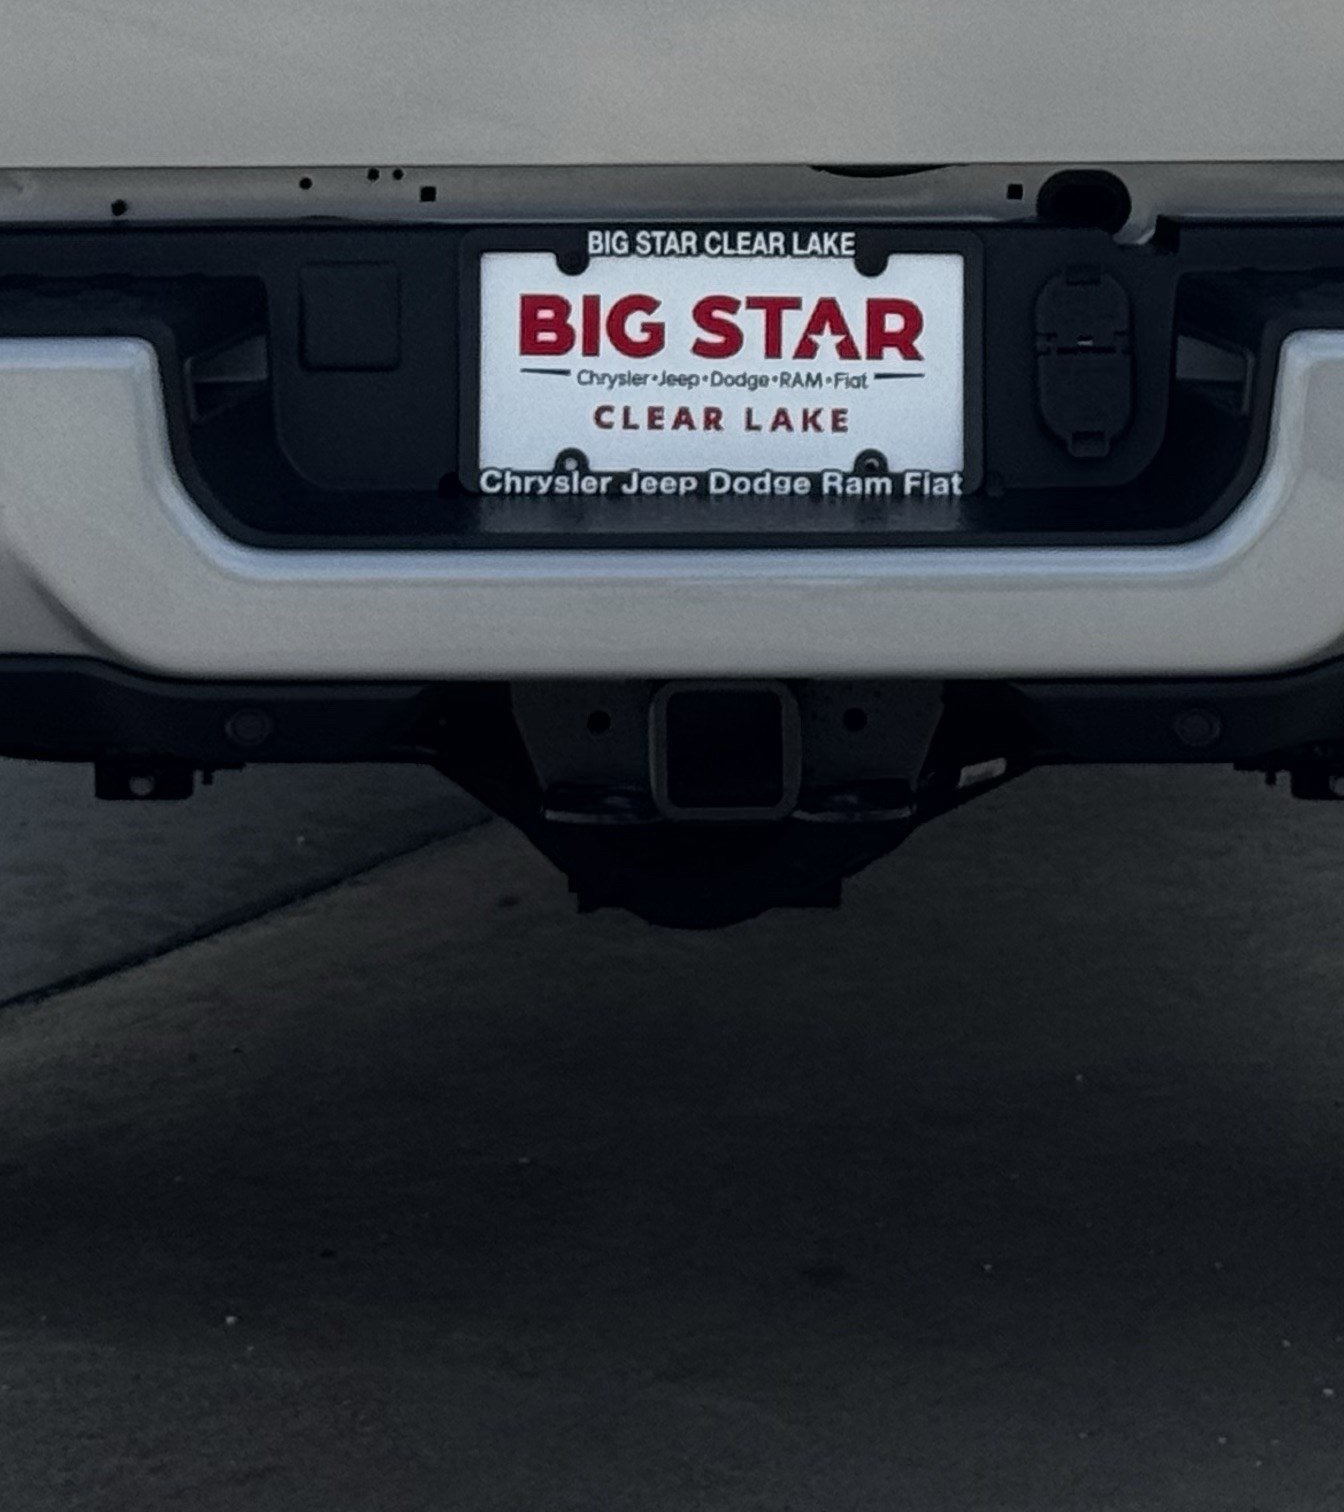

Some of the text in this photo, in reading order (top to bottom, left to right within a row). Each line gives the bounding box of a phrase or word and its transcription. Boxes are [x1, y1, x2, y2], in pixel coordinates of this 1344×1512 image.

[588, 230, 856, 256] BIG STAR CLEAR LAKE
[519, 293, 925, 361] BIG STAR
[593, 405, 849, 434] CLEAR LAKE
[479, 470, 964, 498] Chrysler Jeep Dodge Ram Fiat
